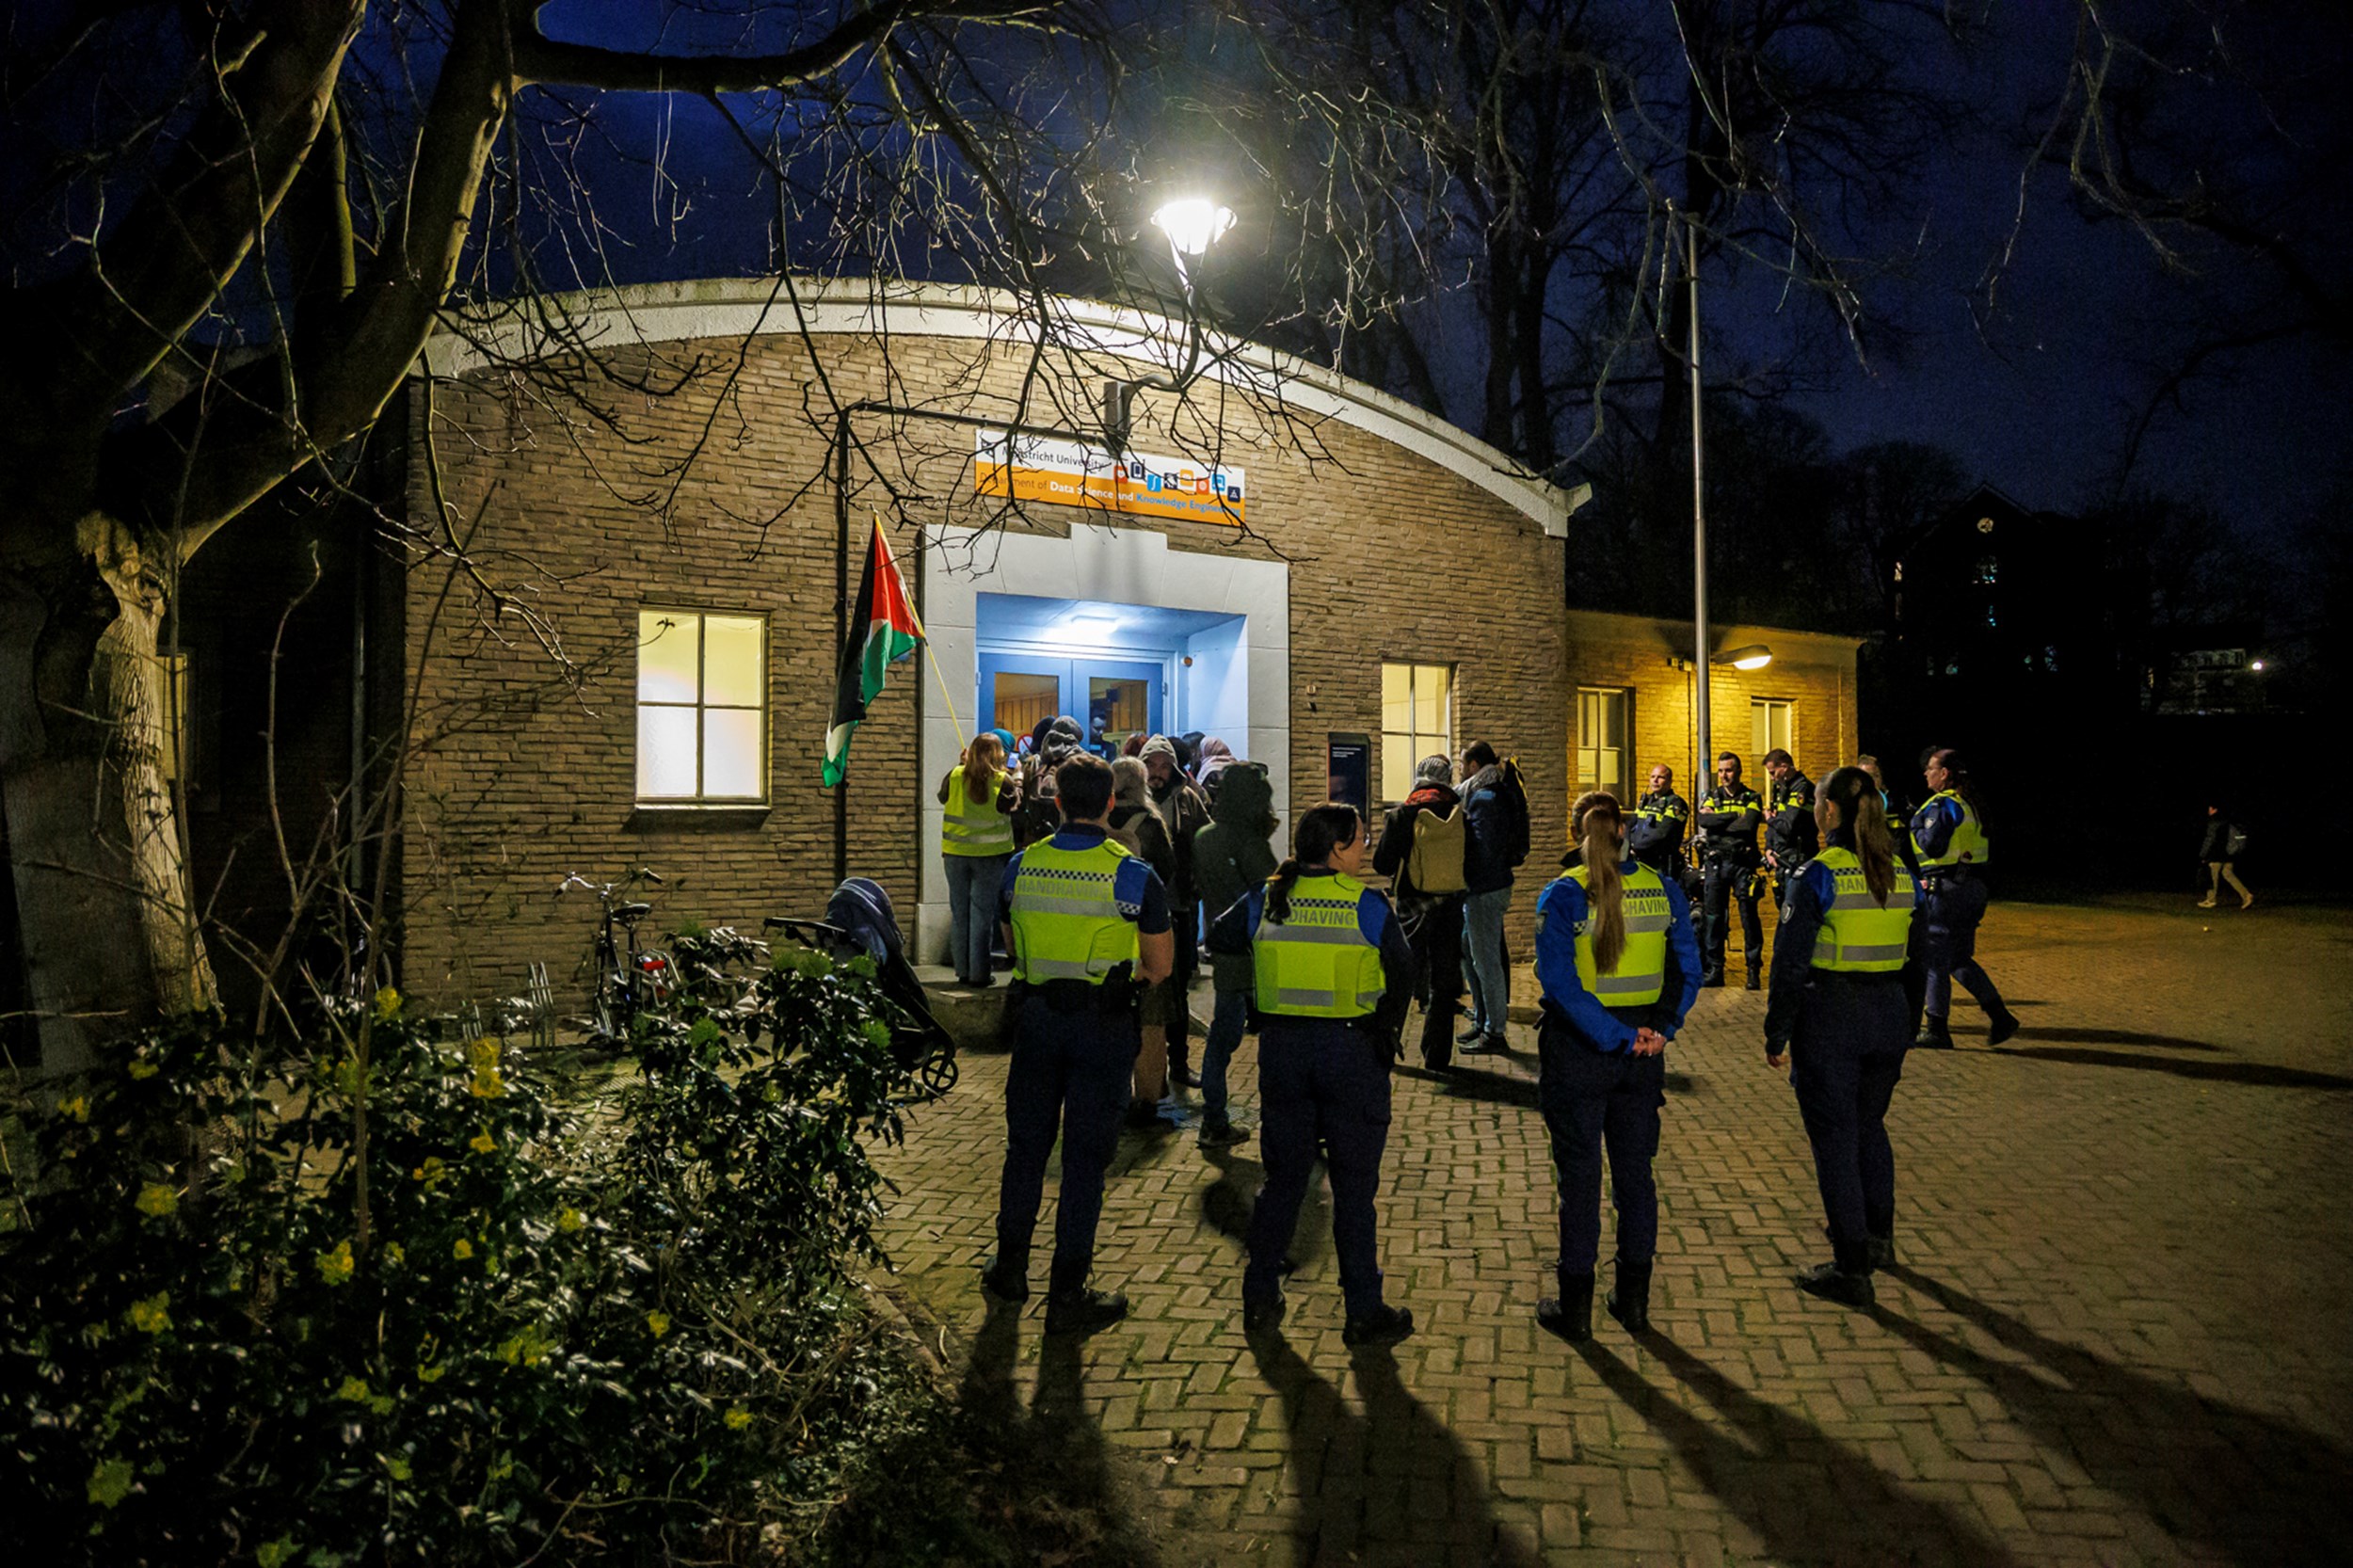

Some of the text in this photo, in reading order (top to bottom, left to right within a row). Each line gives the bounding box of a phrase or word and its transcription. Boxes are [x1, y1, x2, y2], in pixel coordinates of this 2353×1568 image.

[1056, 454, 1104, 472] Univesity
[1037, 479, 1048, 489] of
[1049, 481, 1075, 494] Data
[1136, 493, 1187, 510] Knowledge
[1286, 908, 1355, 926] DHAVING
